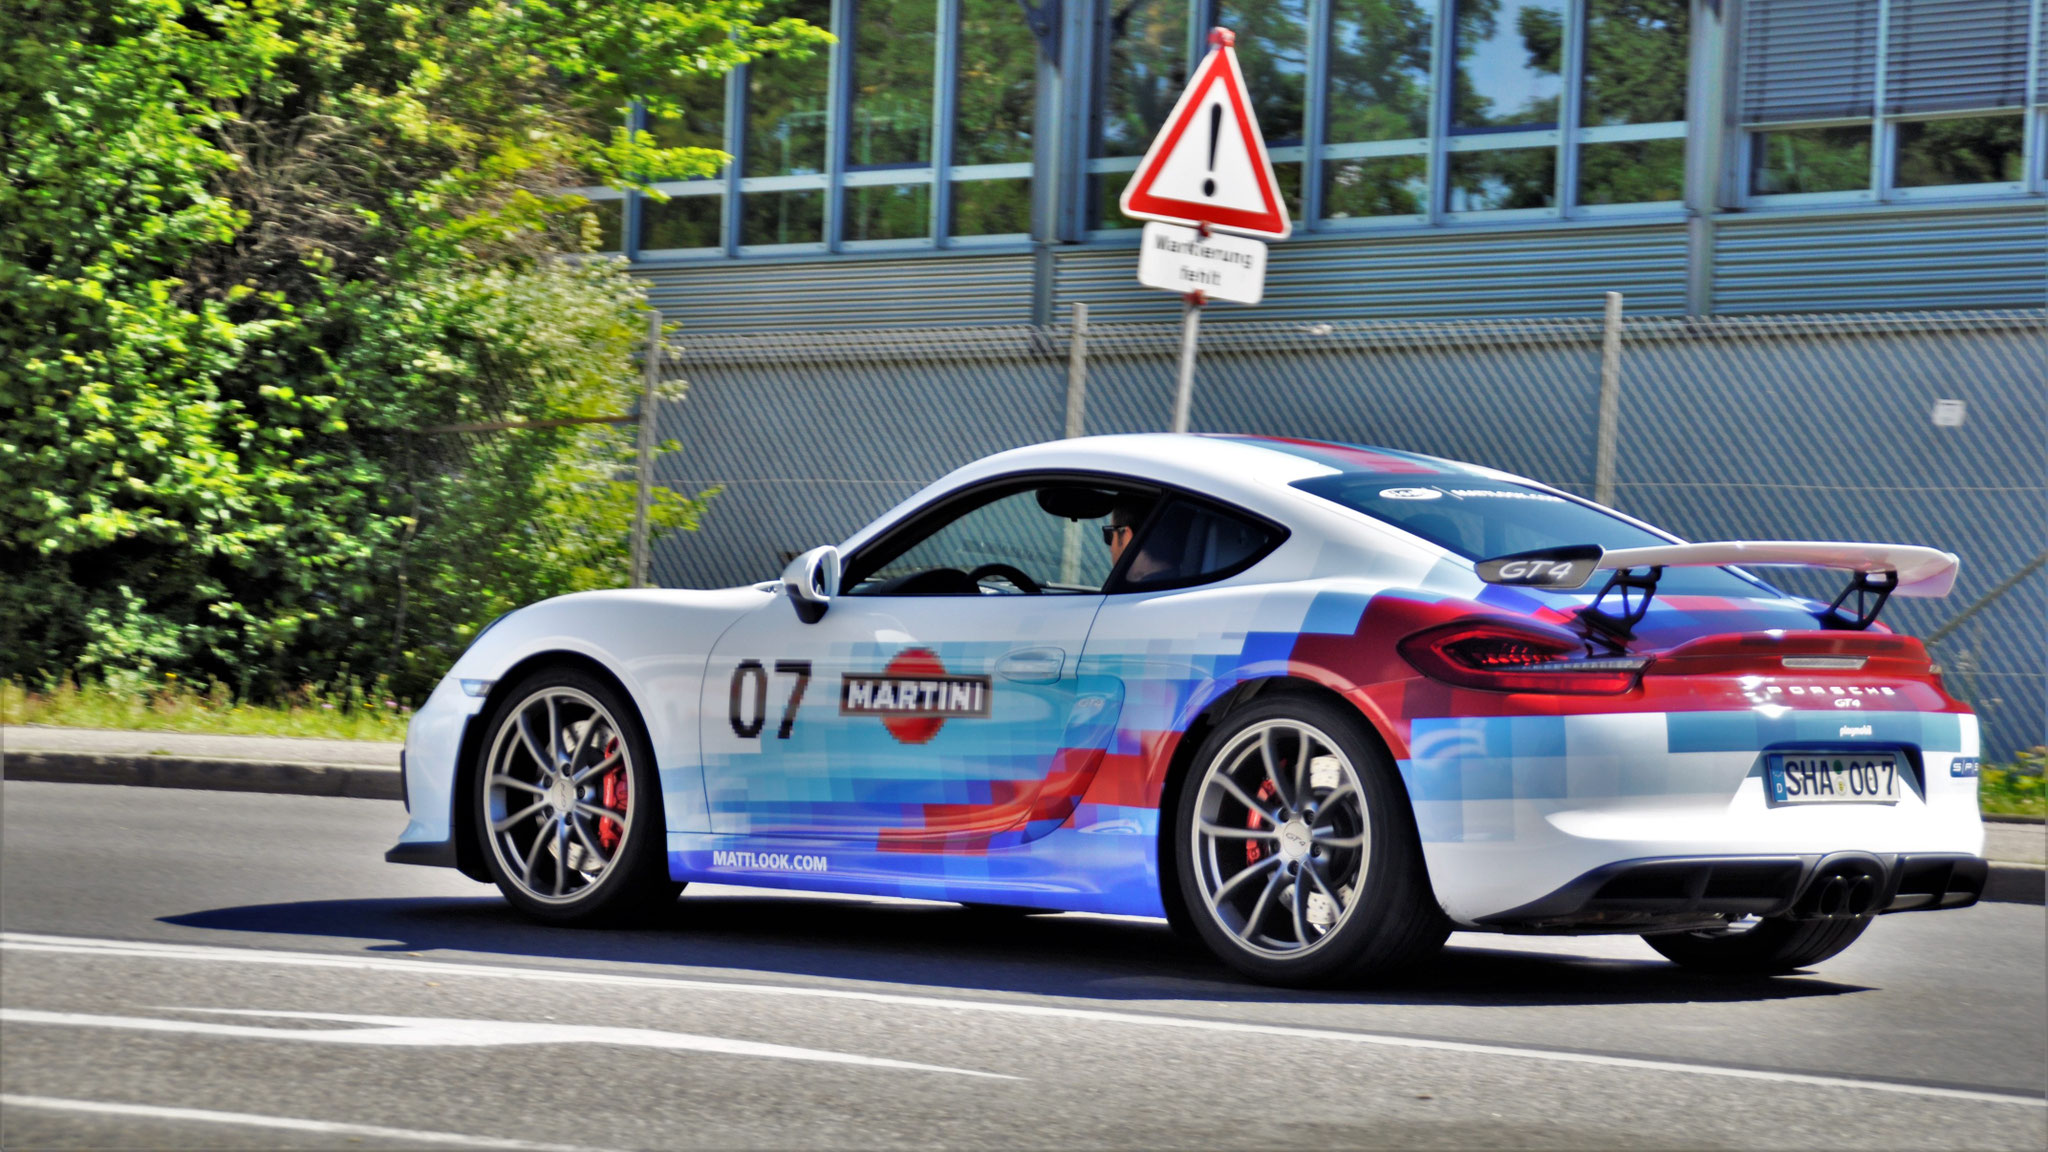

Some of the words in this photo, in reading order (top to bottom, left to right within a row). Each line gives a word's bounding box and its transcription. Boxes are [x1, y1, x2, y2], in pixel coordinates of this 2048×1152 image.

[1499, 560, 1573, 579] GT4
[729, 659, 812, 739] 07
[847, 680, 983, 712] MARTINI
[1767, 686, 1896, 696] PORSCHE
[1834, 698, 1861, 708] GT4
[1785, 760, 1834, 796] SHA
[1849, 760, 1895, 796] 007
[713, 850, 827, 872] MATTLOOK.COM
